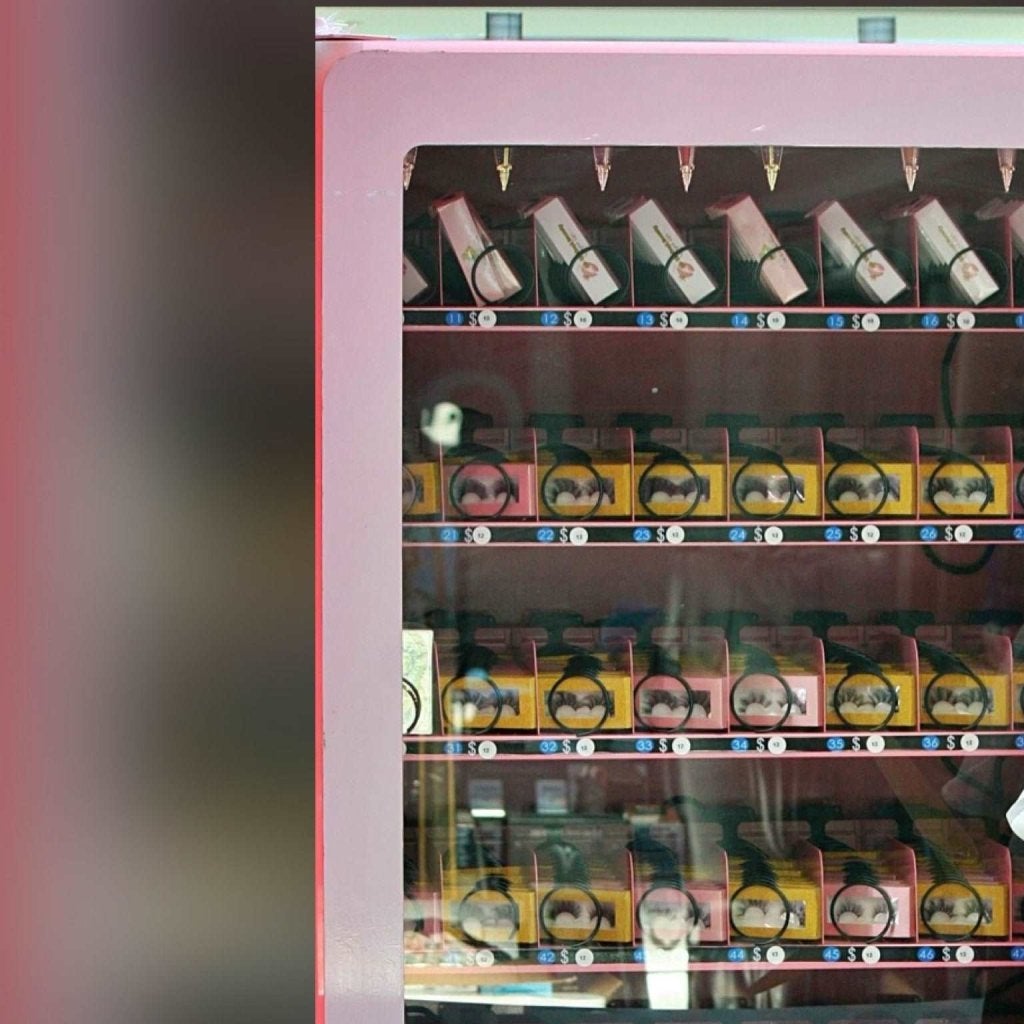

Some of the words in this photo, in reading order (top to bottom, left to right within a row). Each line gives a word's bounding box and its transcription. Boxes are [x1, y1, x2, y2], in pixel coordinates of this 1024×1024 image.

[448, 313, 462, 324] 11
[469, 312, 477, 326] $
[545, 314, 559, 324] 12
[563, 312, 572, 326] $
[638, 314, 652, 325] 13
[660, 313, 668, 327] $
[733, 315, 747, 325] 14
[756, 314, 764, 328] $
[829, 317, 843, 327] 15
[852, 315, 860, 329] $
[924, 316, 938, 326] 16
[947, 314, 955, 328] $
[442, 530, 456, 540] 21
[464, 528, 473, 542] $
[539, 529, 553, 539] 22
[560, 528, 568, 542] $
[635, 529, 649, 540] 23
[657, 528, 665, 542] $
[730, 529, 744, 540] 24
[754, 528, 763, 542] $
[826, 529, 840, 539] 25
[850, 527, 858, 541] $
[922, 528, 936, 539] 26
[945, 527, 953, 541] $
[446, 743, 460, 753] 31
[468, 741, 476, 755] $
[542, 742, 556, 752] 32
[562, 740, 571, 754] $
[638, 740, 652, 751] 33
[659, 739, 667, 753] $
[733, 740, 747, 750] 34
[756, 738, 764, 753] $
[829, 738, 843, 749] 35
[852, 737, 860, 751] $
[924, 738, 938, 748] 36
[947, 735, 955, 750] $
[540, 952, 554, 962] 42
[560, 950, 569, 964] $
[730, 950, 744, 960] 44
[753, 948, 761, 962] $
[825, 949, 839, 960] 45
[848, 947, 856, 962] $
[920, 949, 934, 959] 46
[942, 947, 950, 961] $
